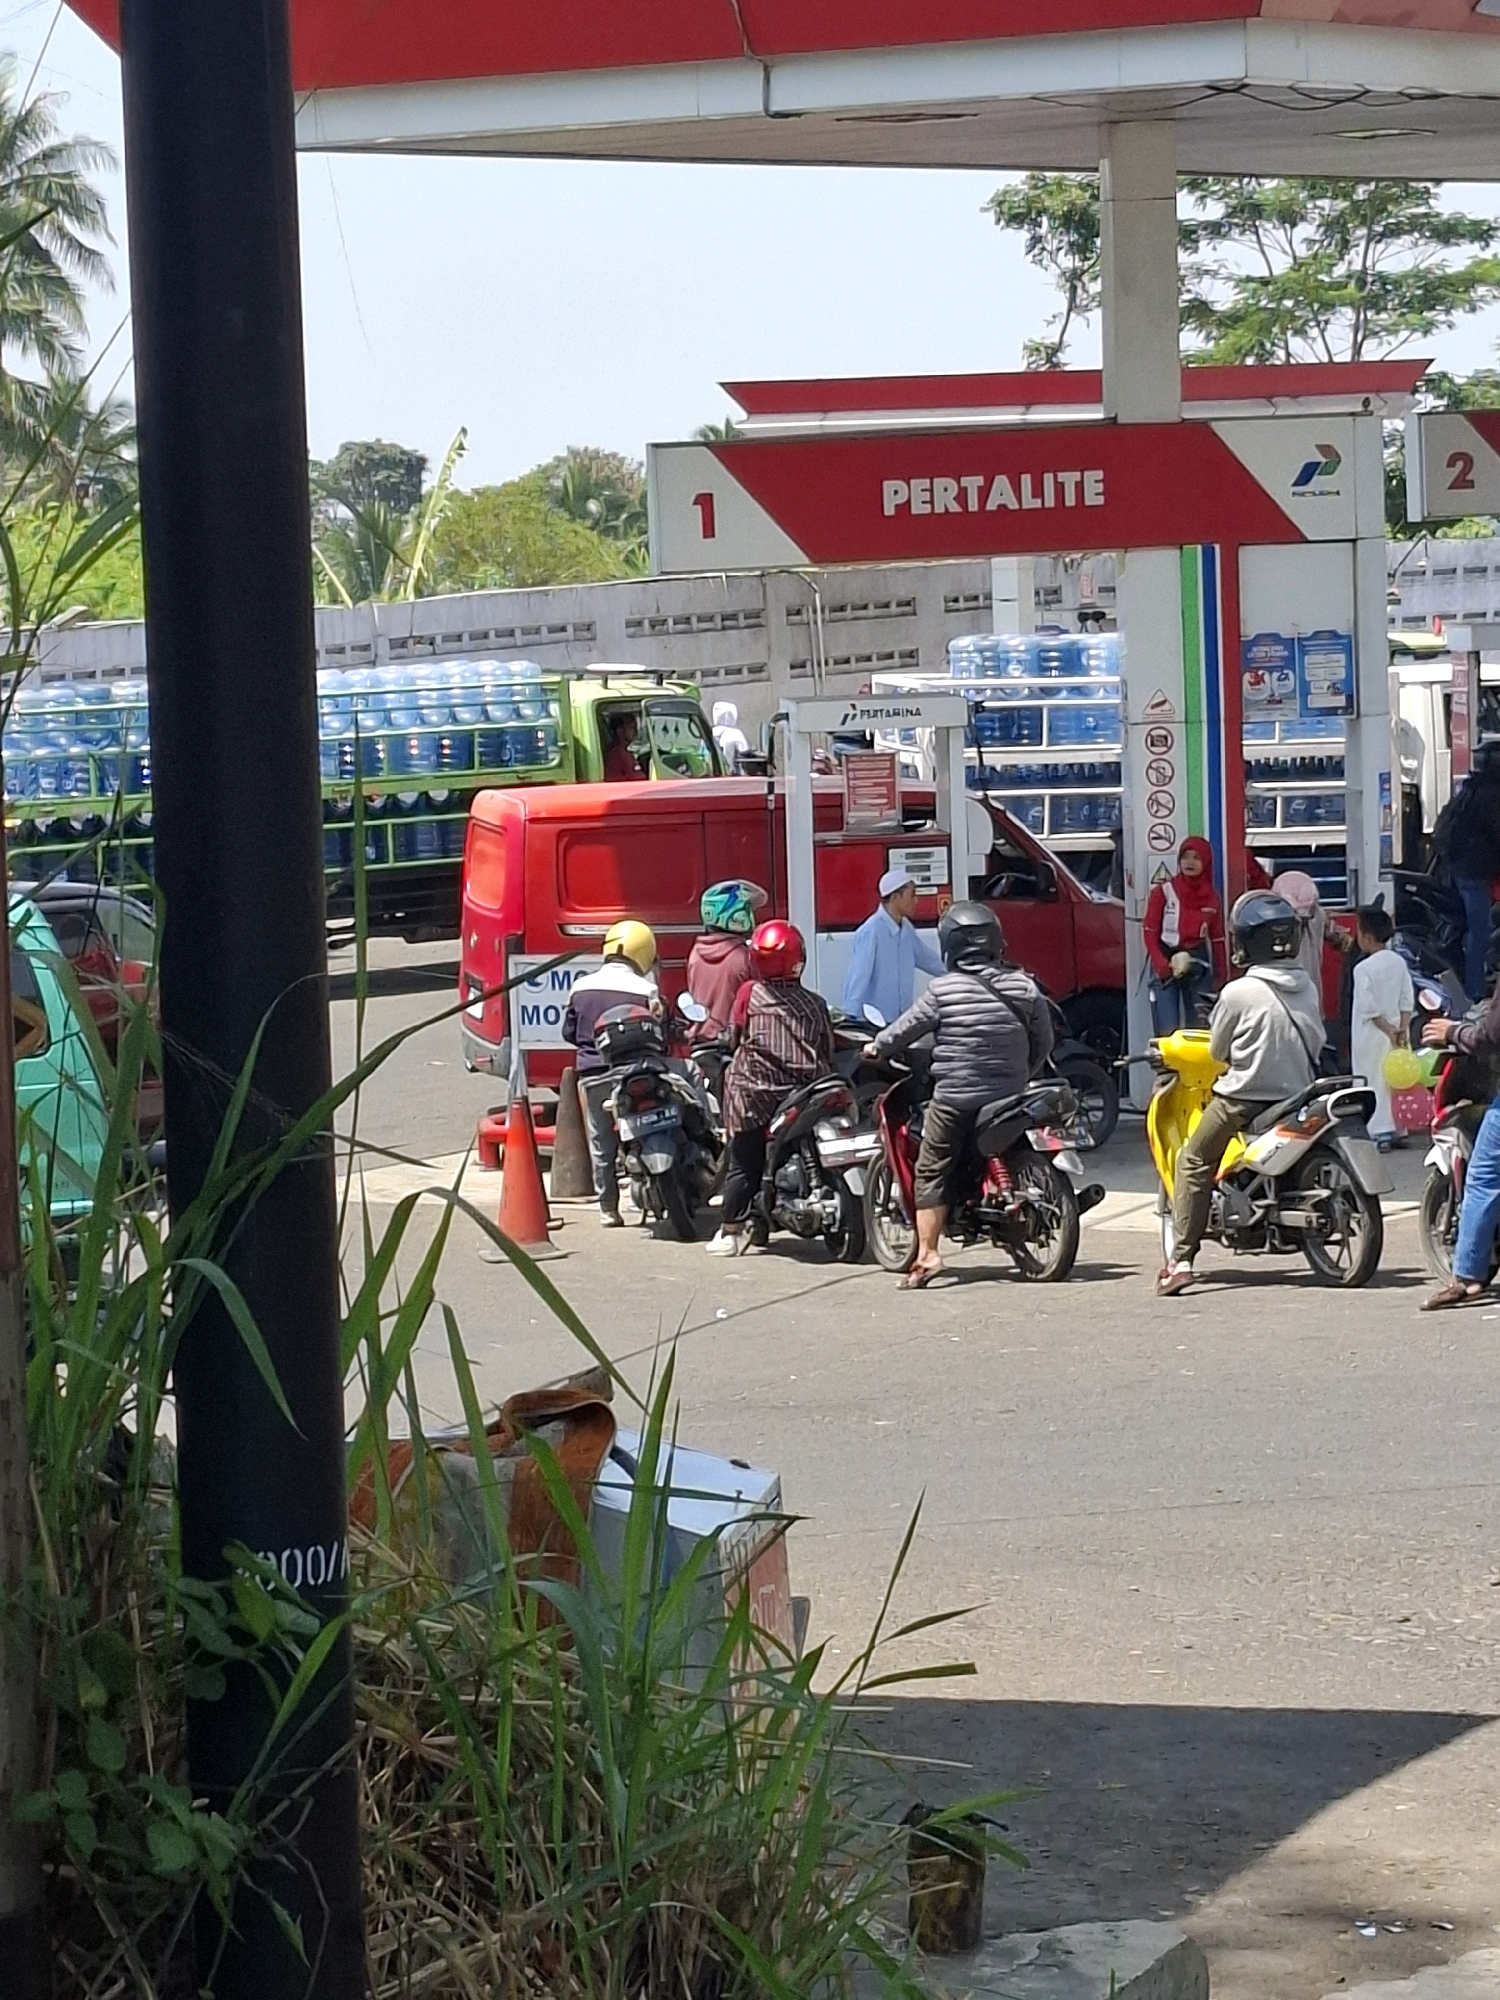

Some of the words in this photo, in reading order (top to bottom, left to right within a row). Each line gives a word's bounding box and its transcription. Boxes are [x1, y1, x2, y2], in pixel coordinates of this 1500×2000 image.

[881, 469, 1105, 517] PERTALITE
[1446, 451, 1476, 491] 2
[692, 492, 716, 540] 1
[520, 1003, 568, 1026] MO
